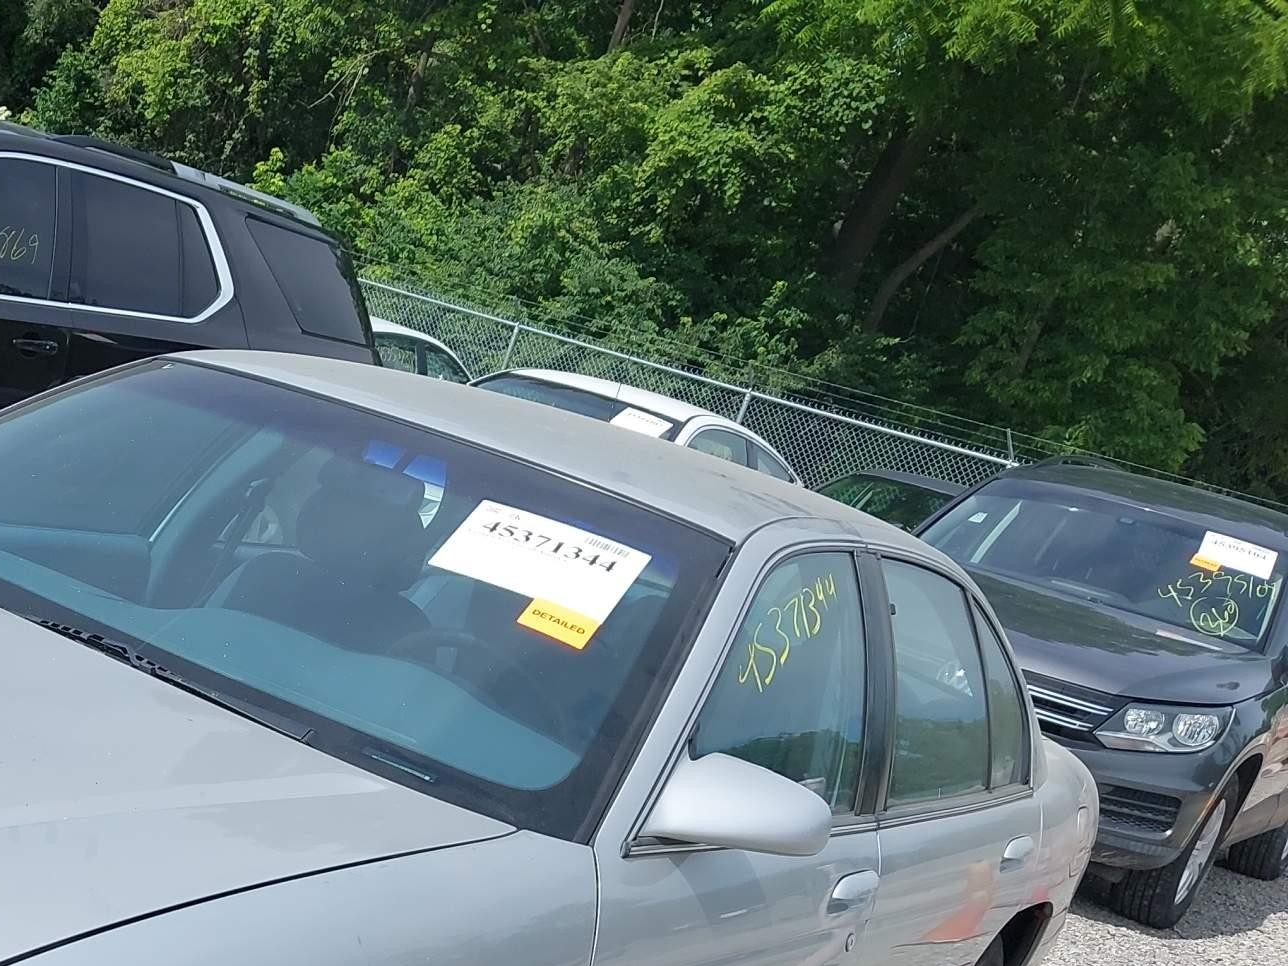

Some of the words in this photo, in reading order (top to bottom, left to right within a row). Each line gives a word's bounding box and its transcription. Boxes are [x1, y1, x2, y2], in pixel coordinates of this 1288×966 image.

[482, 520, 617, 572] 45371344
[532, 608, 586, 636] DETAILED
[739, 573, 838, 693] 45371344
